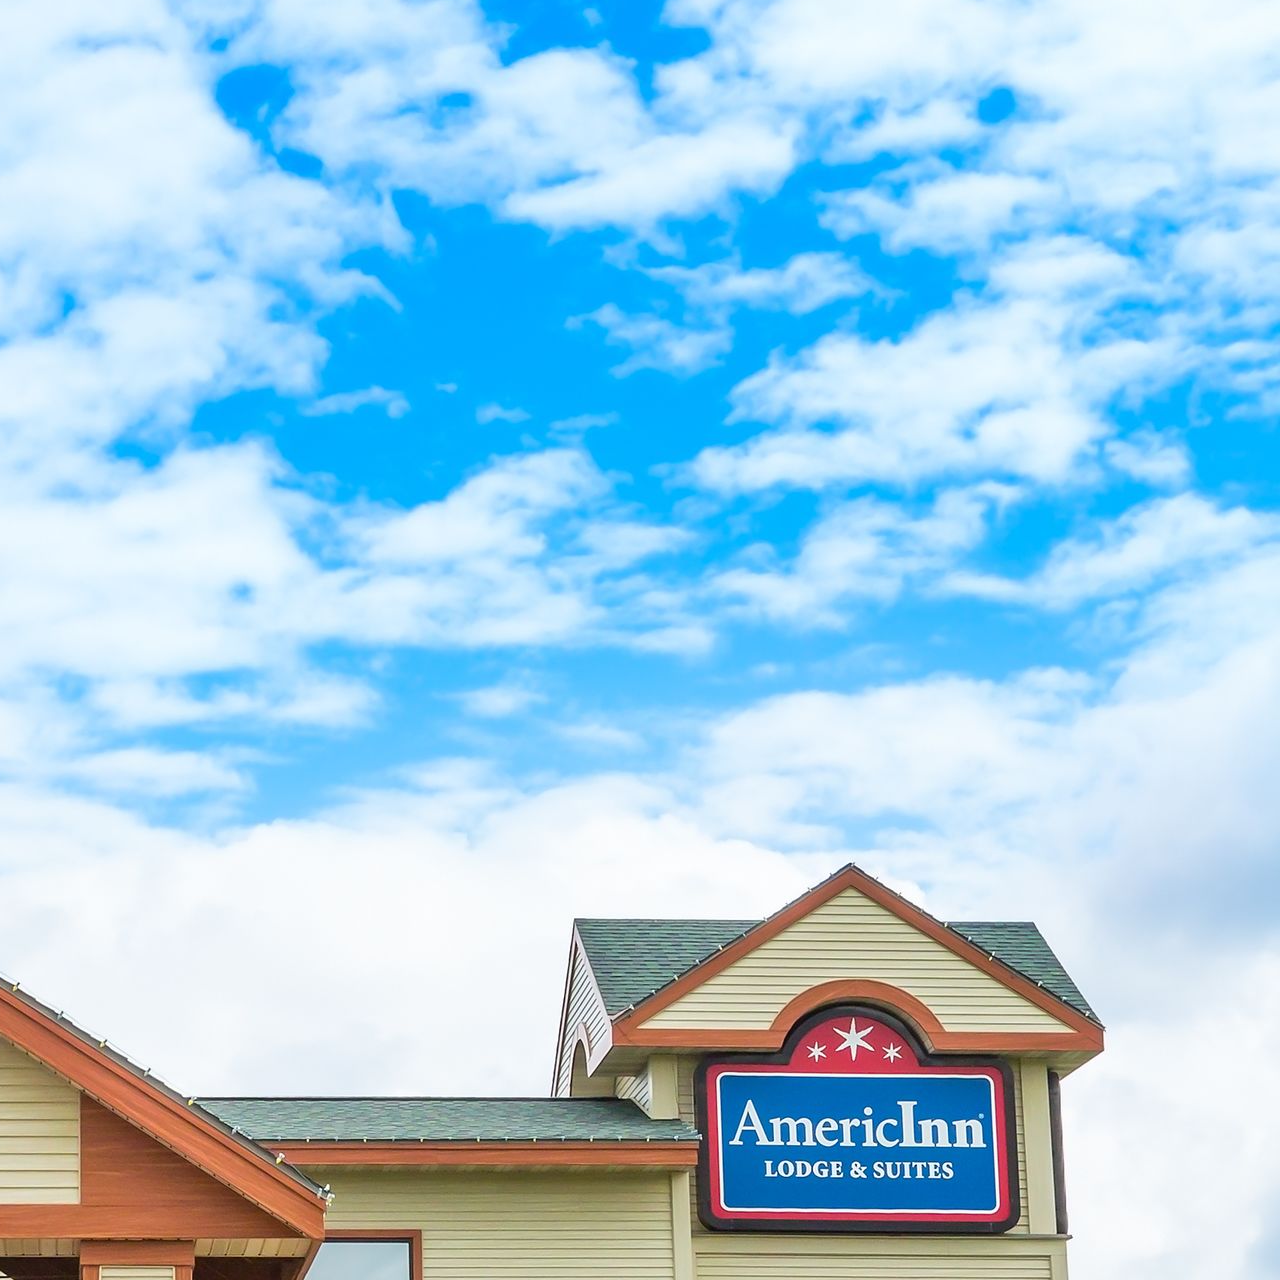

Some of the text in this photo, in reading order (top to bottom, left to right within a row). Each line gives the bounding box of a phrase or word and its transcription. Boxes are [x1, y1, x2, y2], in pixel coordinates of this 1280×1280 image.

[728, 1099, 987, 1148] AmericInn
[764, 1160, 954, 1180] LODGE & SUITES
